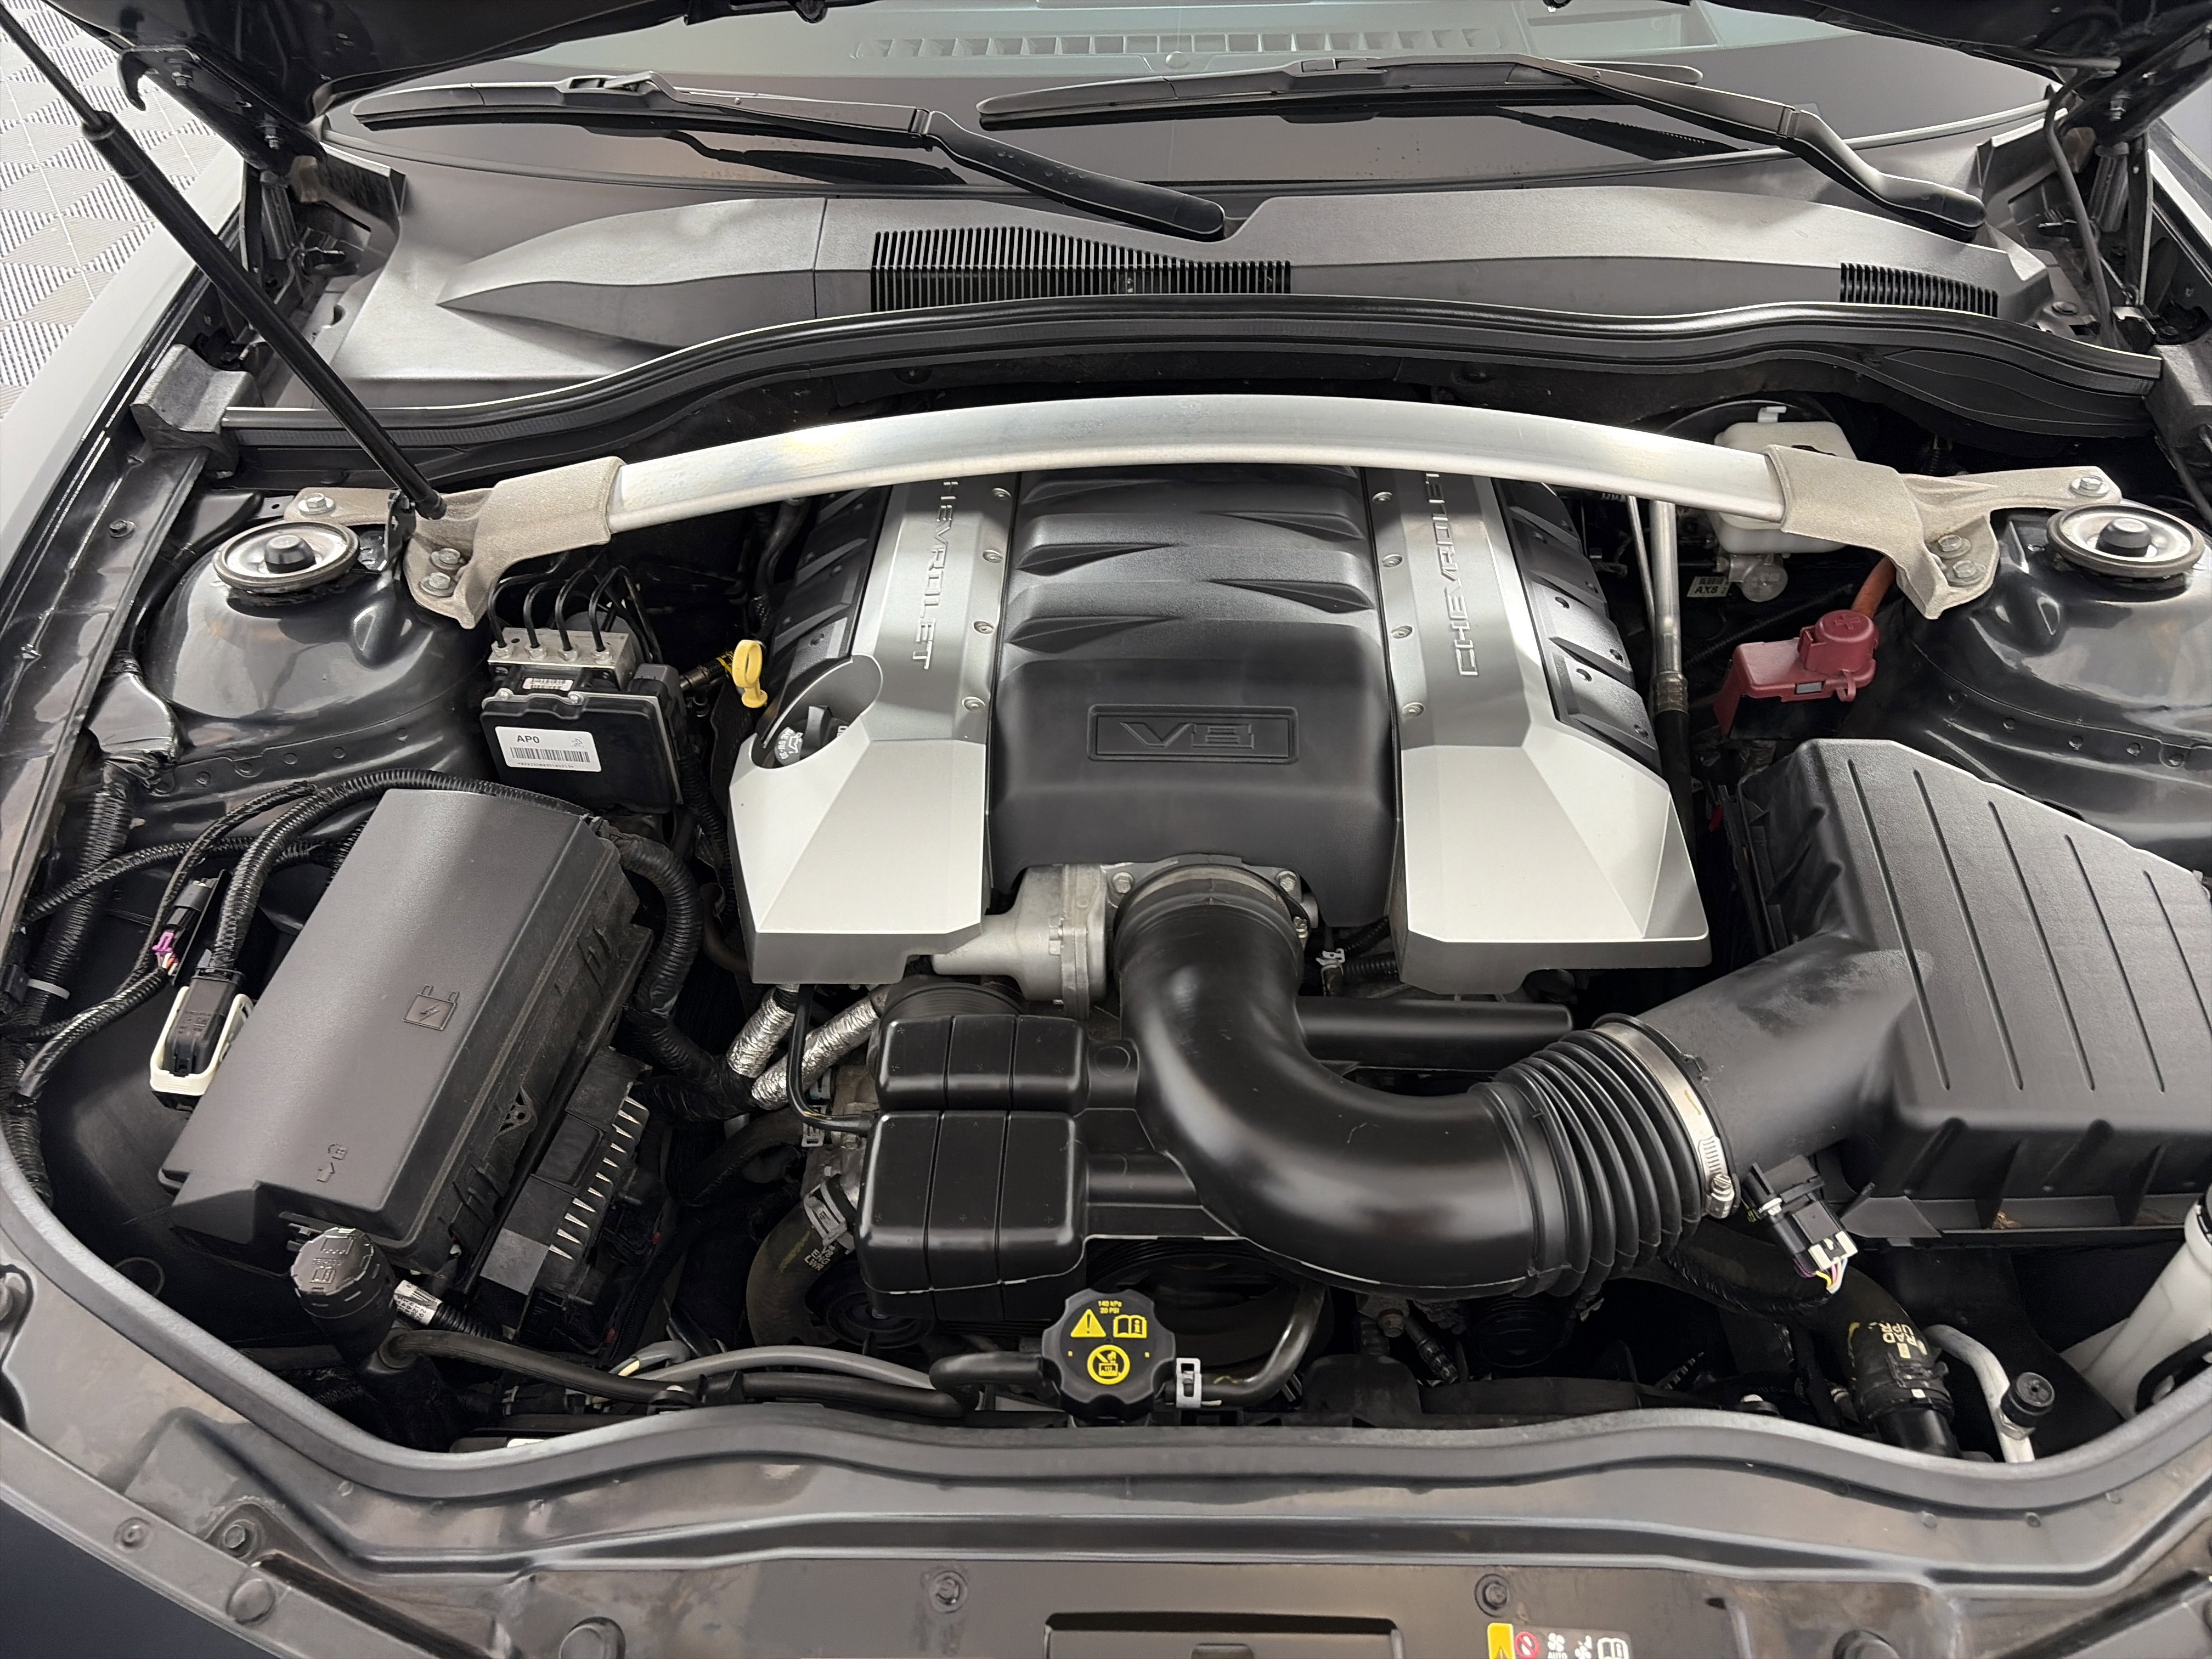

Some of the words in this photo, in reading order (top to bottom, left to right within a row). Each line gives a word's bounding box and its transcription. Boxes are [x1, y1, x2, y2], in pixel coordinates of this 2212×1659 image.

[912, 480, 959, 670] HEVROLET
[1119, 721, 1254, 749] V8
[1878, 1322, 1914, 1335] UPR
[1882, 1332, 1918, 1347] RAD
